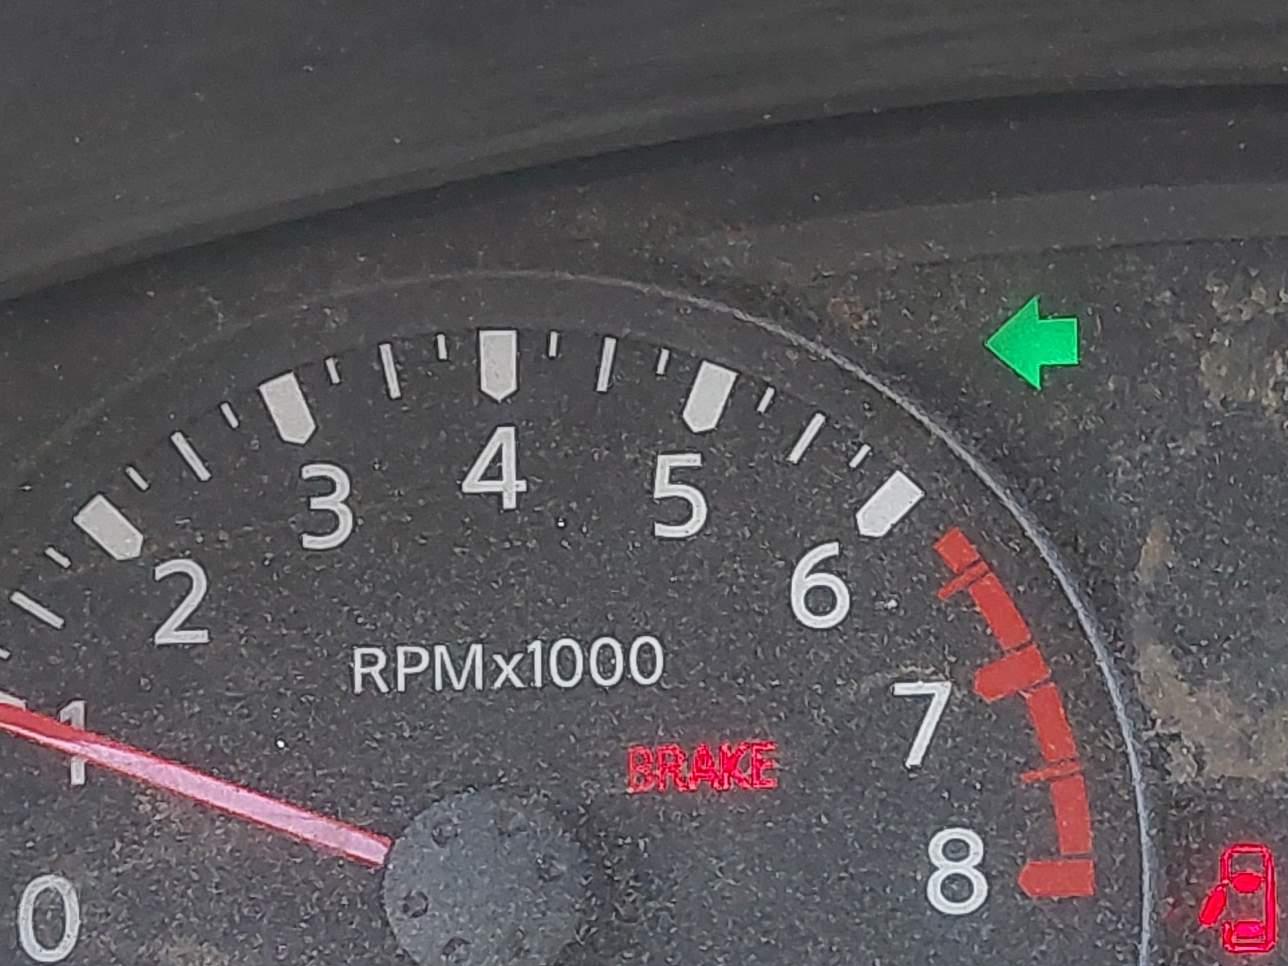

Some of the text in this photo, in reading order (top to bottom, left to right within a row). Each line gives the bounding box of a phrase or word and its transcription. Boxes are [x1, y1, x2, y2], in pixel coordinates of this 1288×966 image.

[299, 464, 353, 549] 3
[461, 427, 527, 510] 4
[650, 453, 709, 538] 5
[152, 561, 210, 645] 2
[790, 542, 851, 629] 6
[351, 635, 665, 694] RPMx1000
[628, 739, 779, 794] BRAKE
[889, 681, 953, 768] 7
[926, 828, 989, 914] 8
[18, 873, 81, 963] 0
